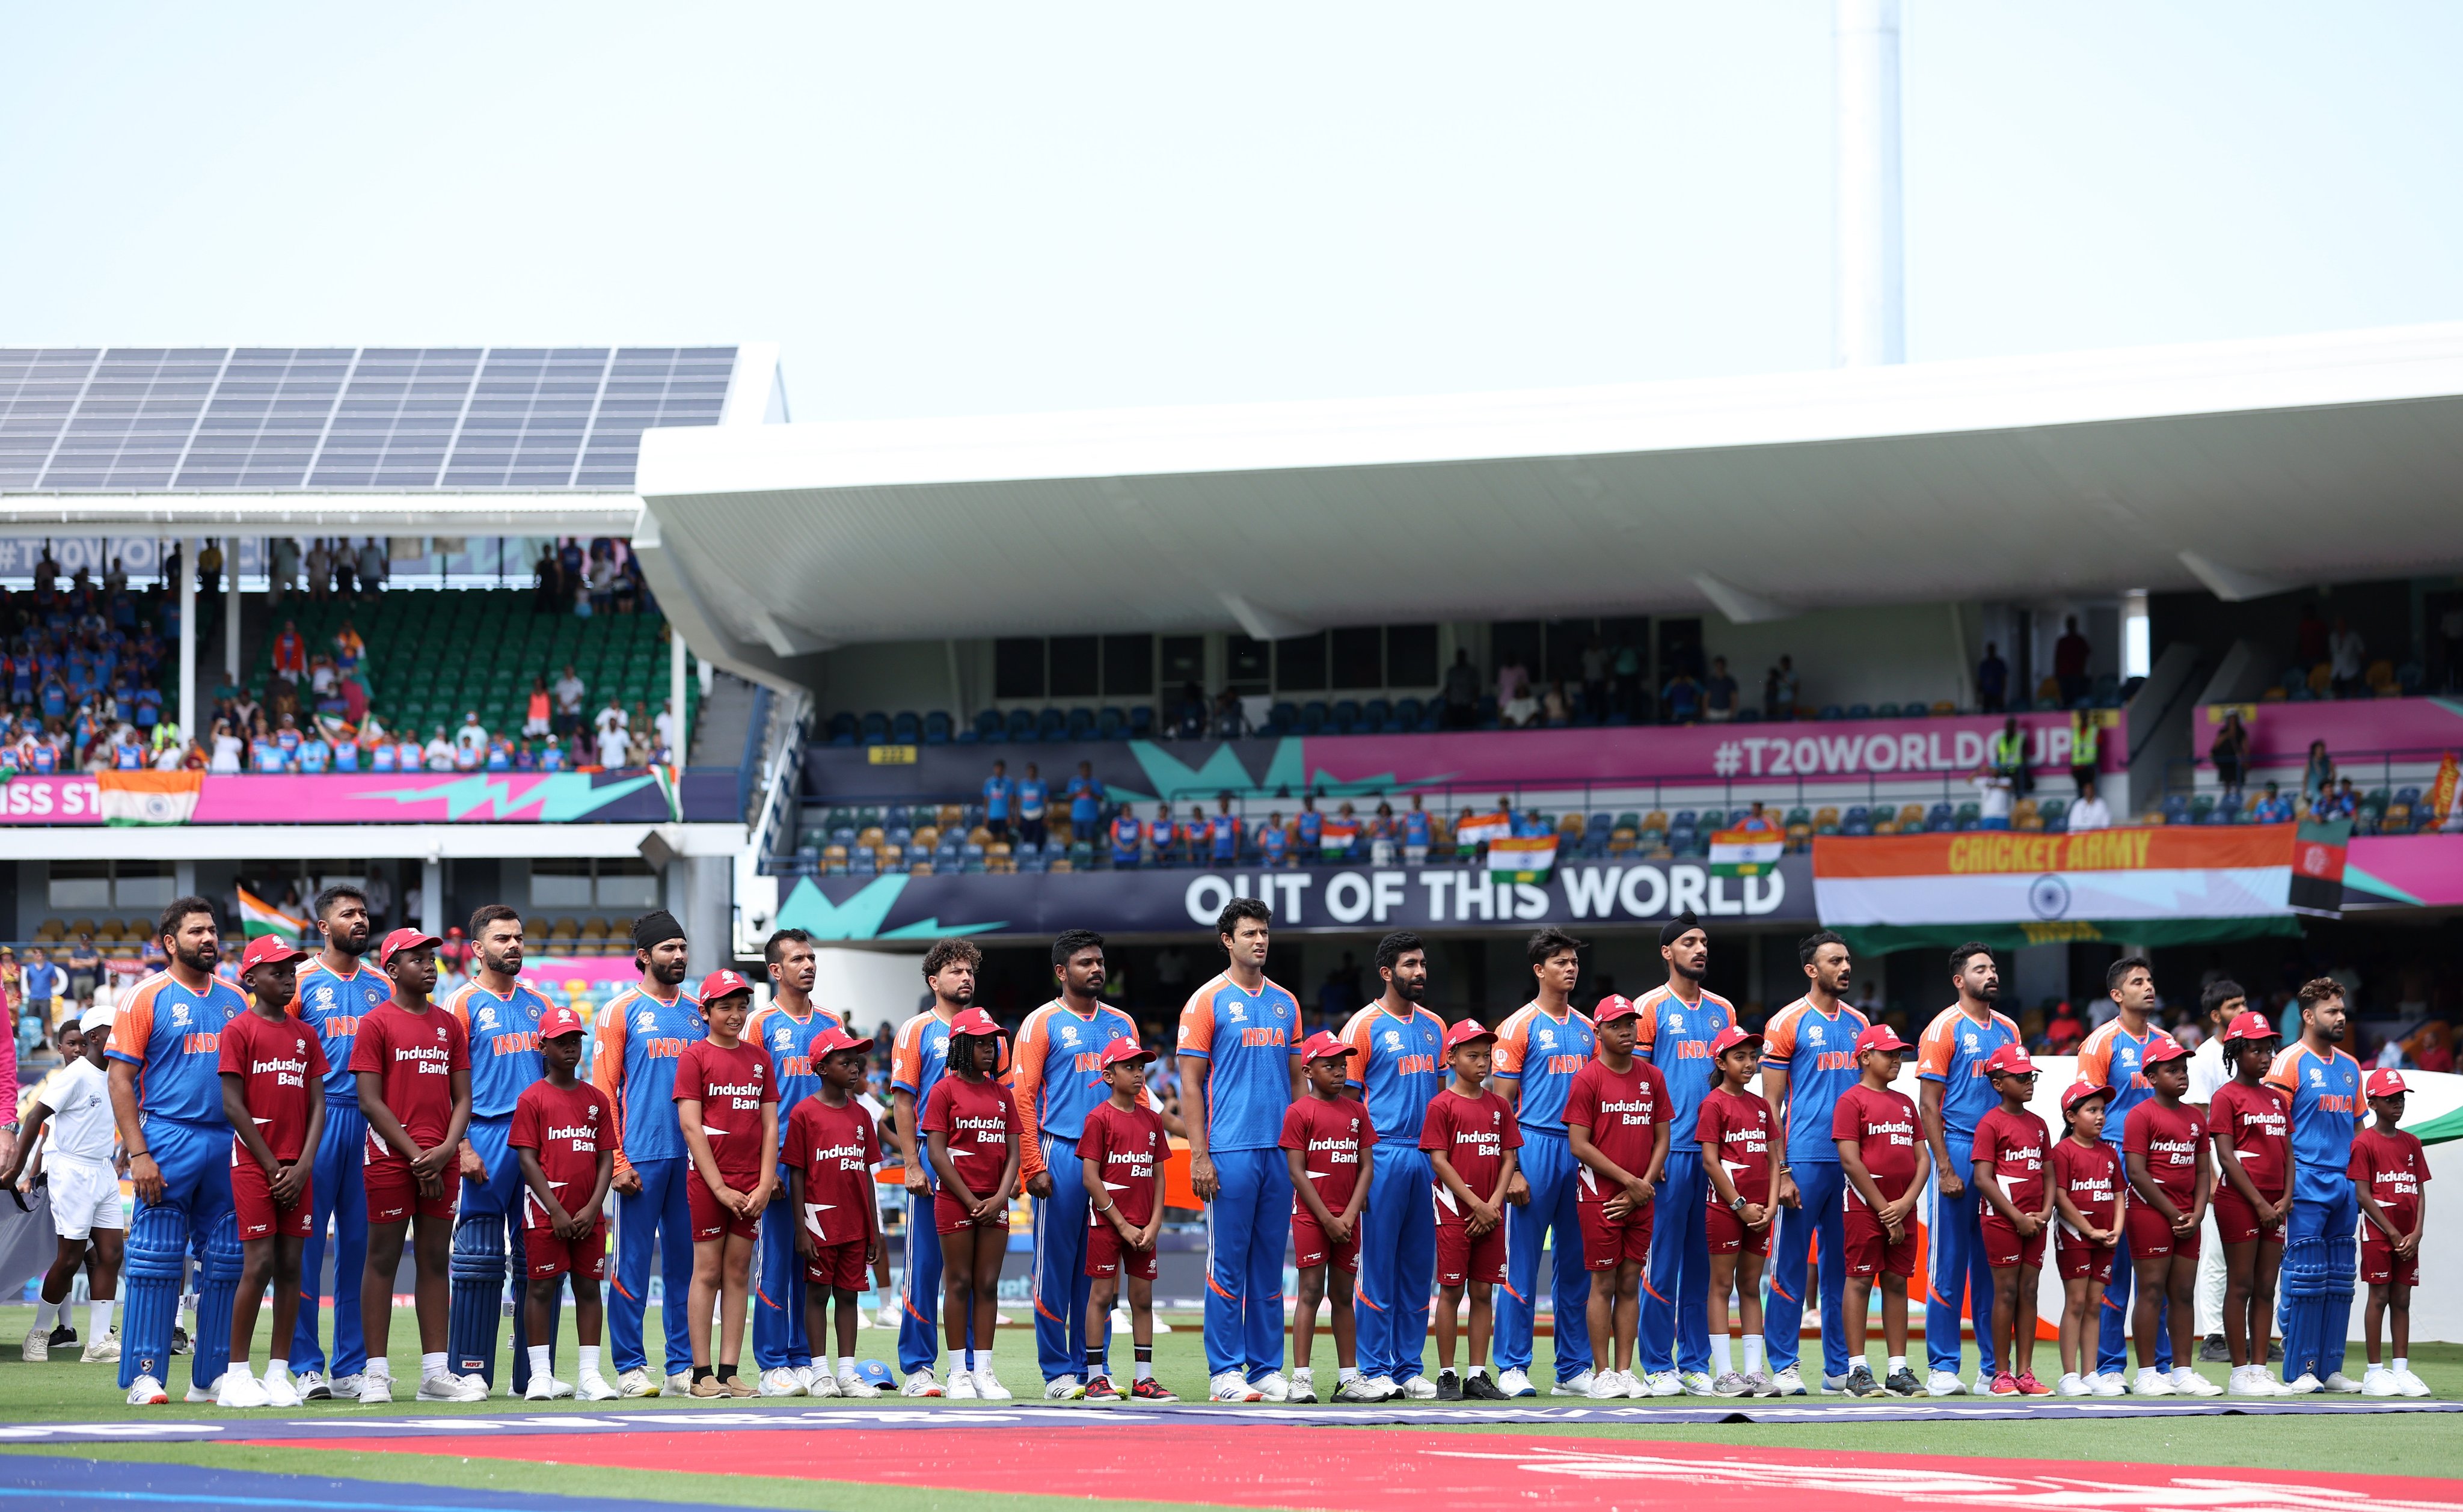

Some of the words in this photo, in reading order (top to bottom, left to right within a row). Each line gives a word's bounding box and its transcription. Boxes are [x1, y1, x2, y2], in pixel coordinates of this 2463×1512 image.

[1948, 834, 2063, 874] CRICKET
[2066, 829, 2152, 870] ARMY
[1185, 873, 1313, 926] OUT
[1325, 871, 1408, 924] OF
[1419, 870, 1550, 922] THIS
[1560, 865, 1785, 919] WORLD
[183, 1033, 221, 1054] IND
[1241, 1027, 1285, 1047] INDIA
[419, 1061, 449, 1075] Bank
[783, 1056, 818, 1077] IND
[1074, 1052, 1102, 1073] IND
[1398, 1054, 1435, 1076] INDIA
[1817, 1051, 1859, 1071] INDIA
[277, 1072, 304, 1088] Bank
[708, 1083, 763, 1096] IndusInd
[1601, 1100, 1653, 1113] IndusInd
[2318, 1095, 2352, 1112] INDIA
[1622, 1113, 1651, 1125] Bank
[1725, 1128, 1765, 1143] IndusIn
[840, 1158, 865, 1172] Bank
[1331, 1151, 1358, 1163] Bank
[2093, 1190, 2114, 1201] Ban
